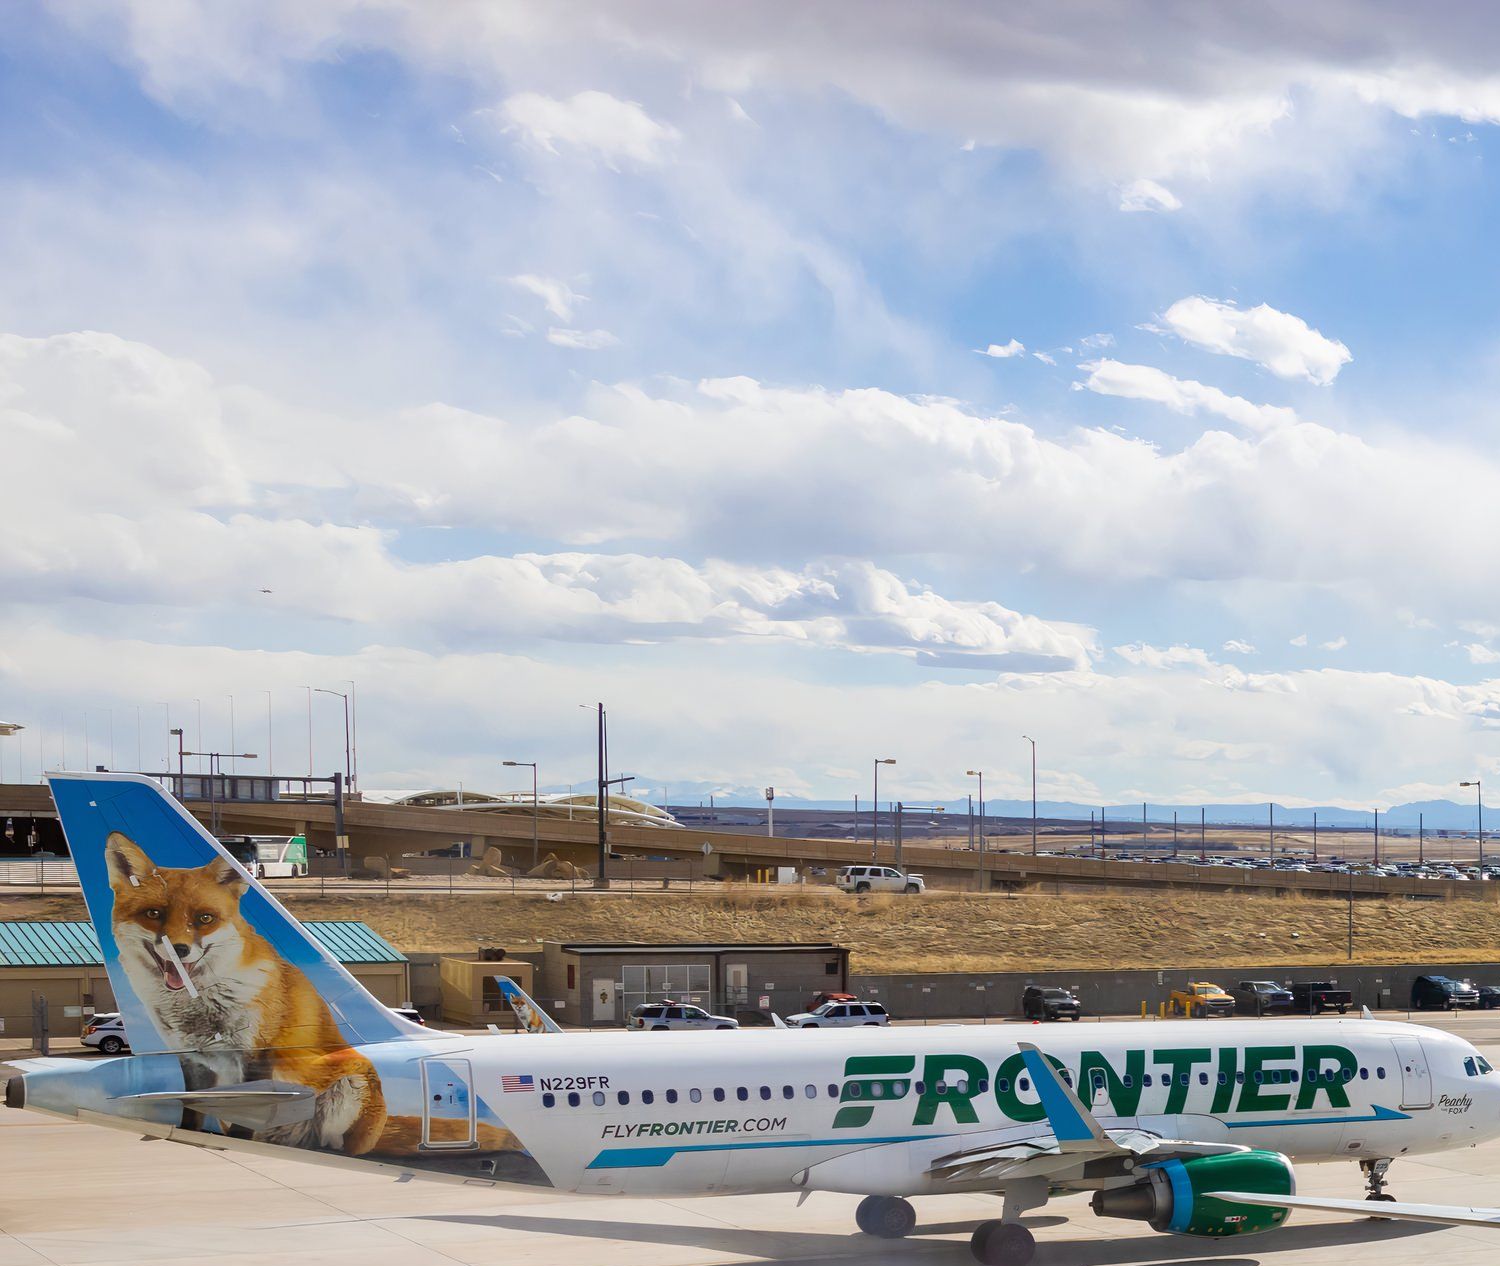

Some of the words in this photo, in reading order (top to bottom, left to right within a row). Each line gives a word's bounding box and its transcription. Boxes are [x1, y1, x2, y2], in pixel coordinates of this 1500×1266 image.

[540, 1076, 610, 1091] N229FR
[832, 1045, 1359, 1128] FRONTIER
[1438, 1093, 1473, 1113] Peachy
[1448, 1107, 1463, 1115] FOX
[601, 1117, 788, 1139] FLYFRONTIER.COM
